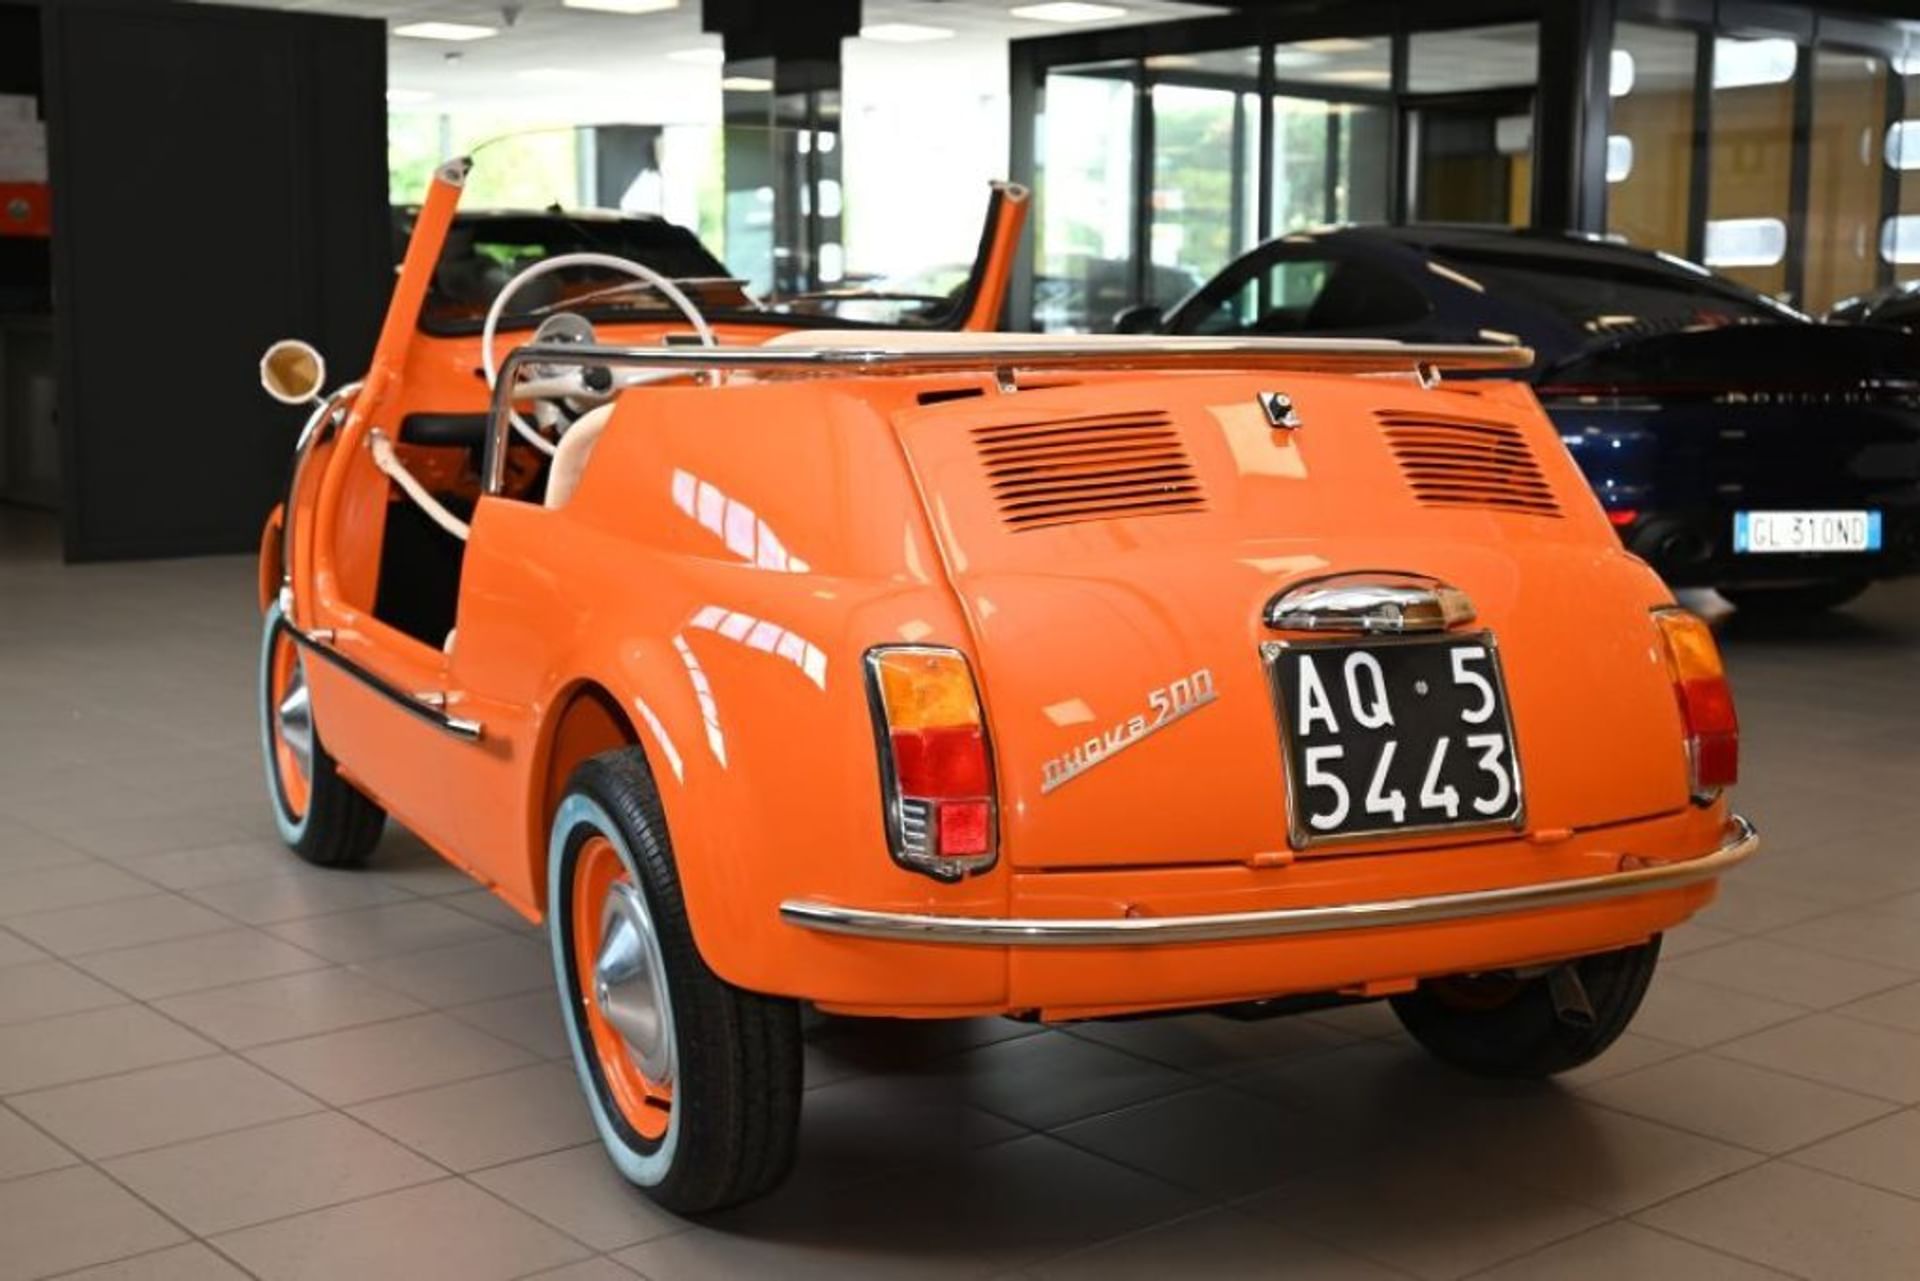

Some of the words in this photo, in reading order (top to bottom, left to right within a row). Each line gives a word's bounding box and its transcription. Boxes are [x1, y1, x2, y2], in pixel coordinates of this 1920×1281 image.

[1754, 517, 1779, 546] GL
[1148, 668, 1217, 728] 500
[1300, 651, 1395, 736] AQ
[1451, 646, 1496, 724] 5
[1304, 734, 1511, 830] 5443
